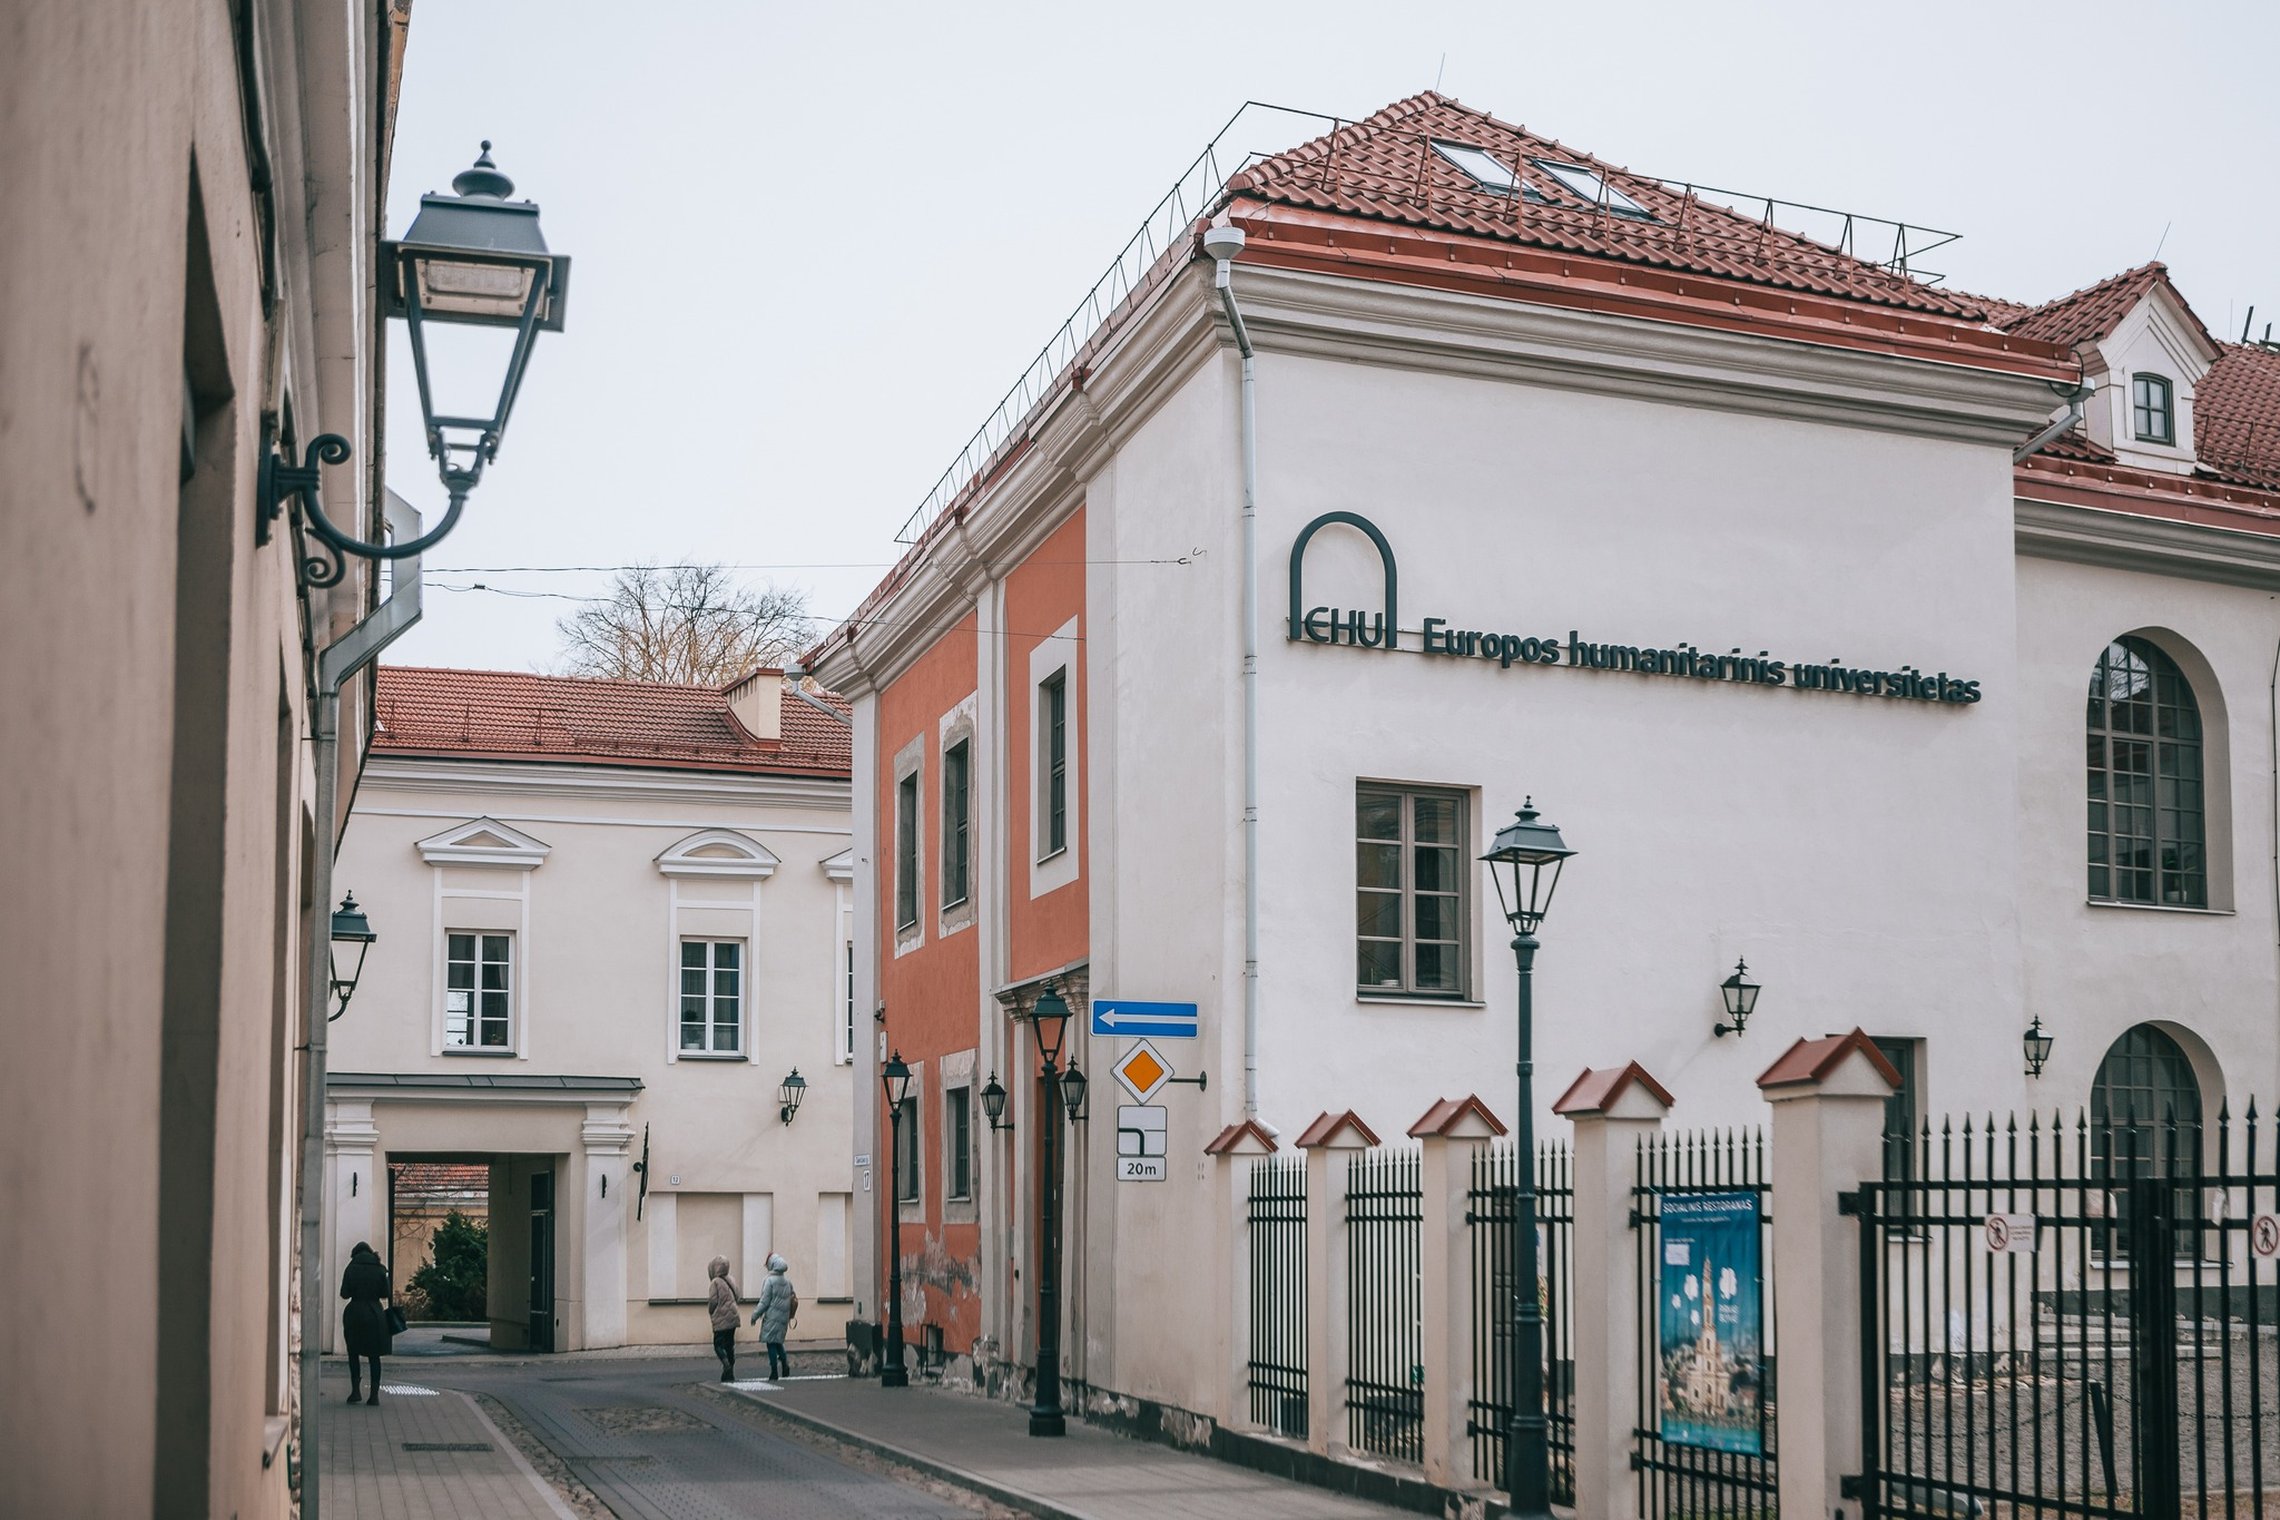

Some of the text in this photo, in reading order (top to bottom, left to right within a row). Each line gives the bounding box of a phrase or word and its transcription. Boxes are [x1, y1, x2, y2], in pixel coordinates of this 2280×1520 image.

[1423, 617, 1982, 704] Europos humanitarinis universitetas
